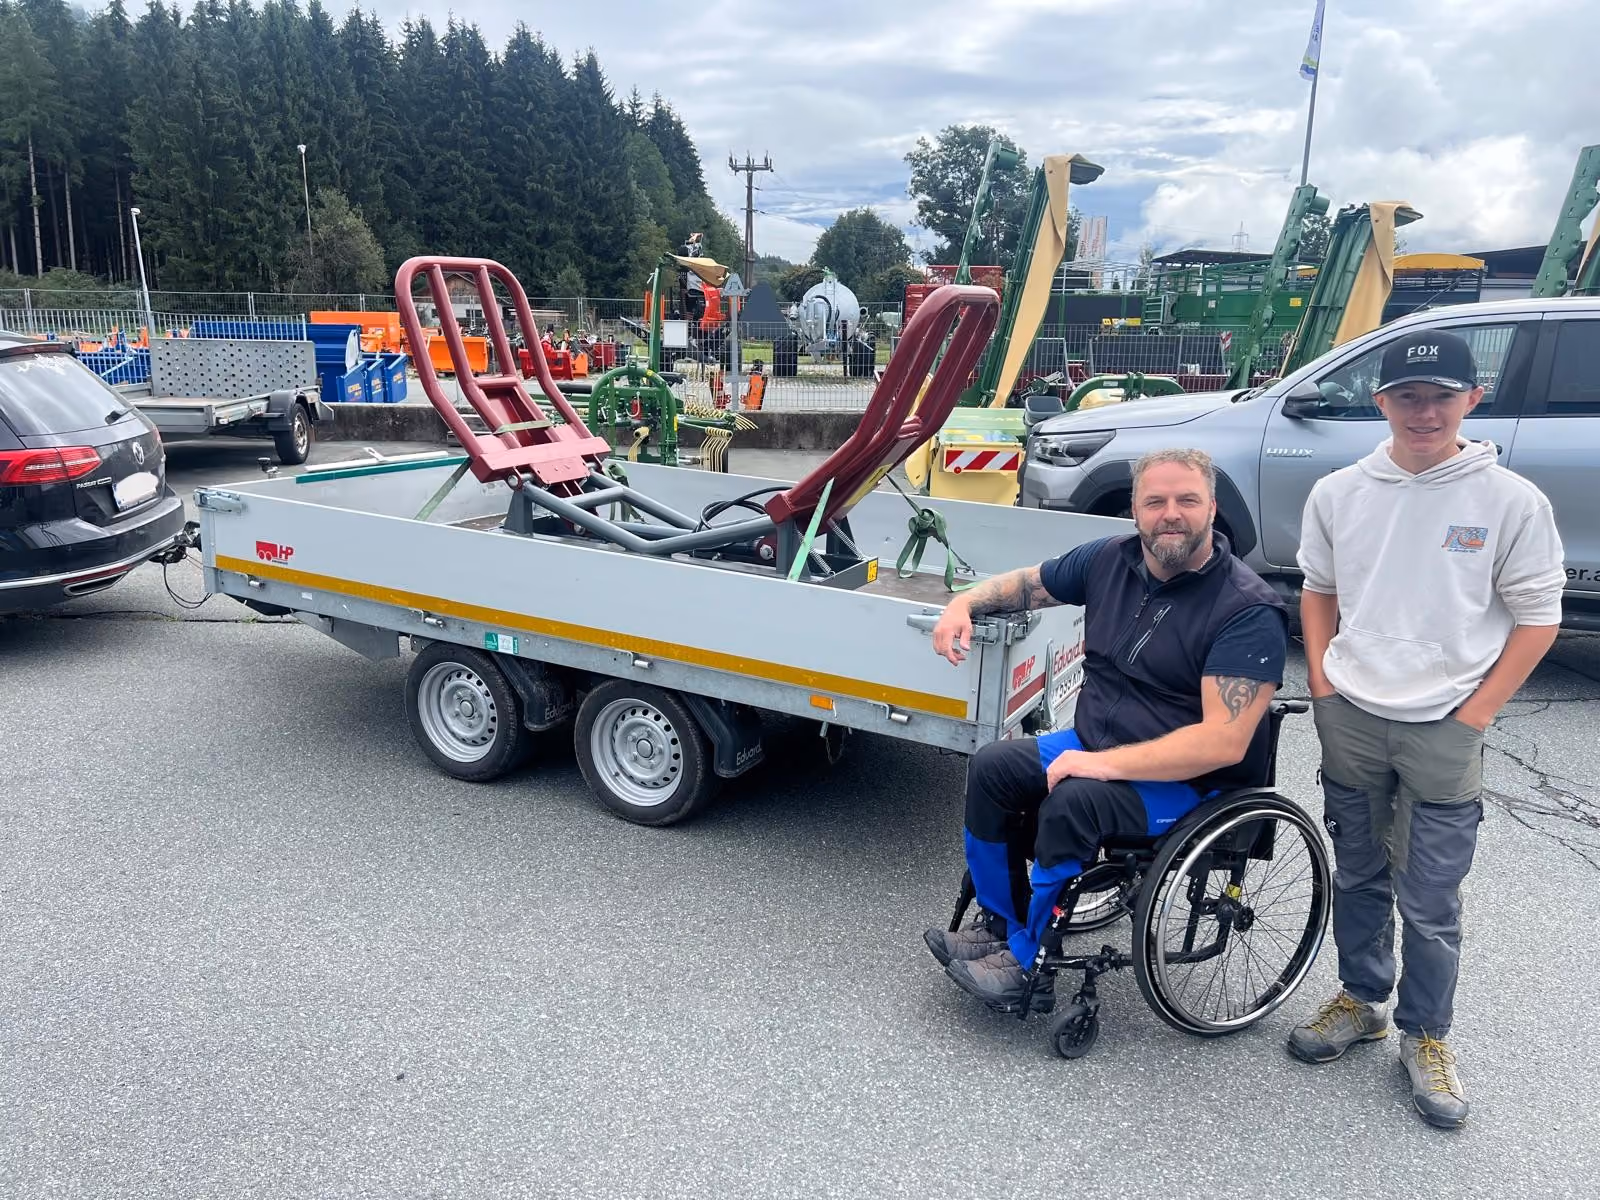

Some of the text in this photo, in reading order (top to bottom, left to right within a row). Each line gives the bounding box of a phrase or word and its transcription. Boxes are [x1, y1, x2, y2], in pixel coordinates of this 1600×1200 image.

[1407, 345, 1439, 357] FOX
[1266, 447, 1314, 458] HILUX
[279, 545, 294, 560] HP
